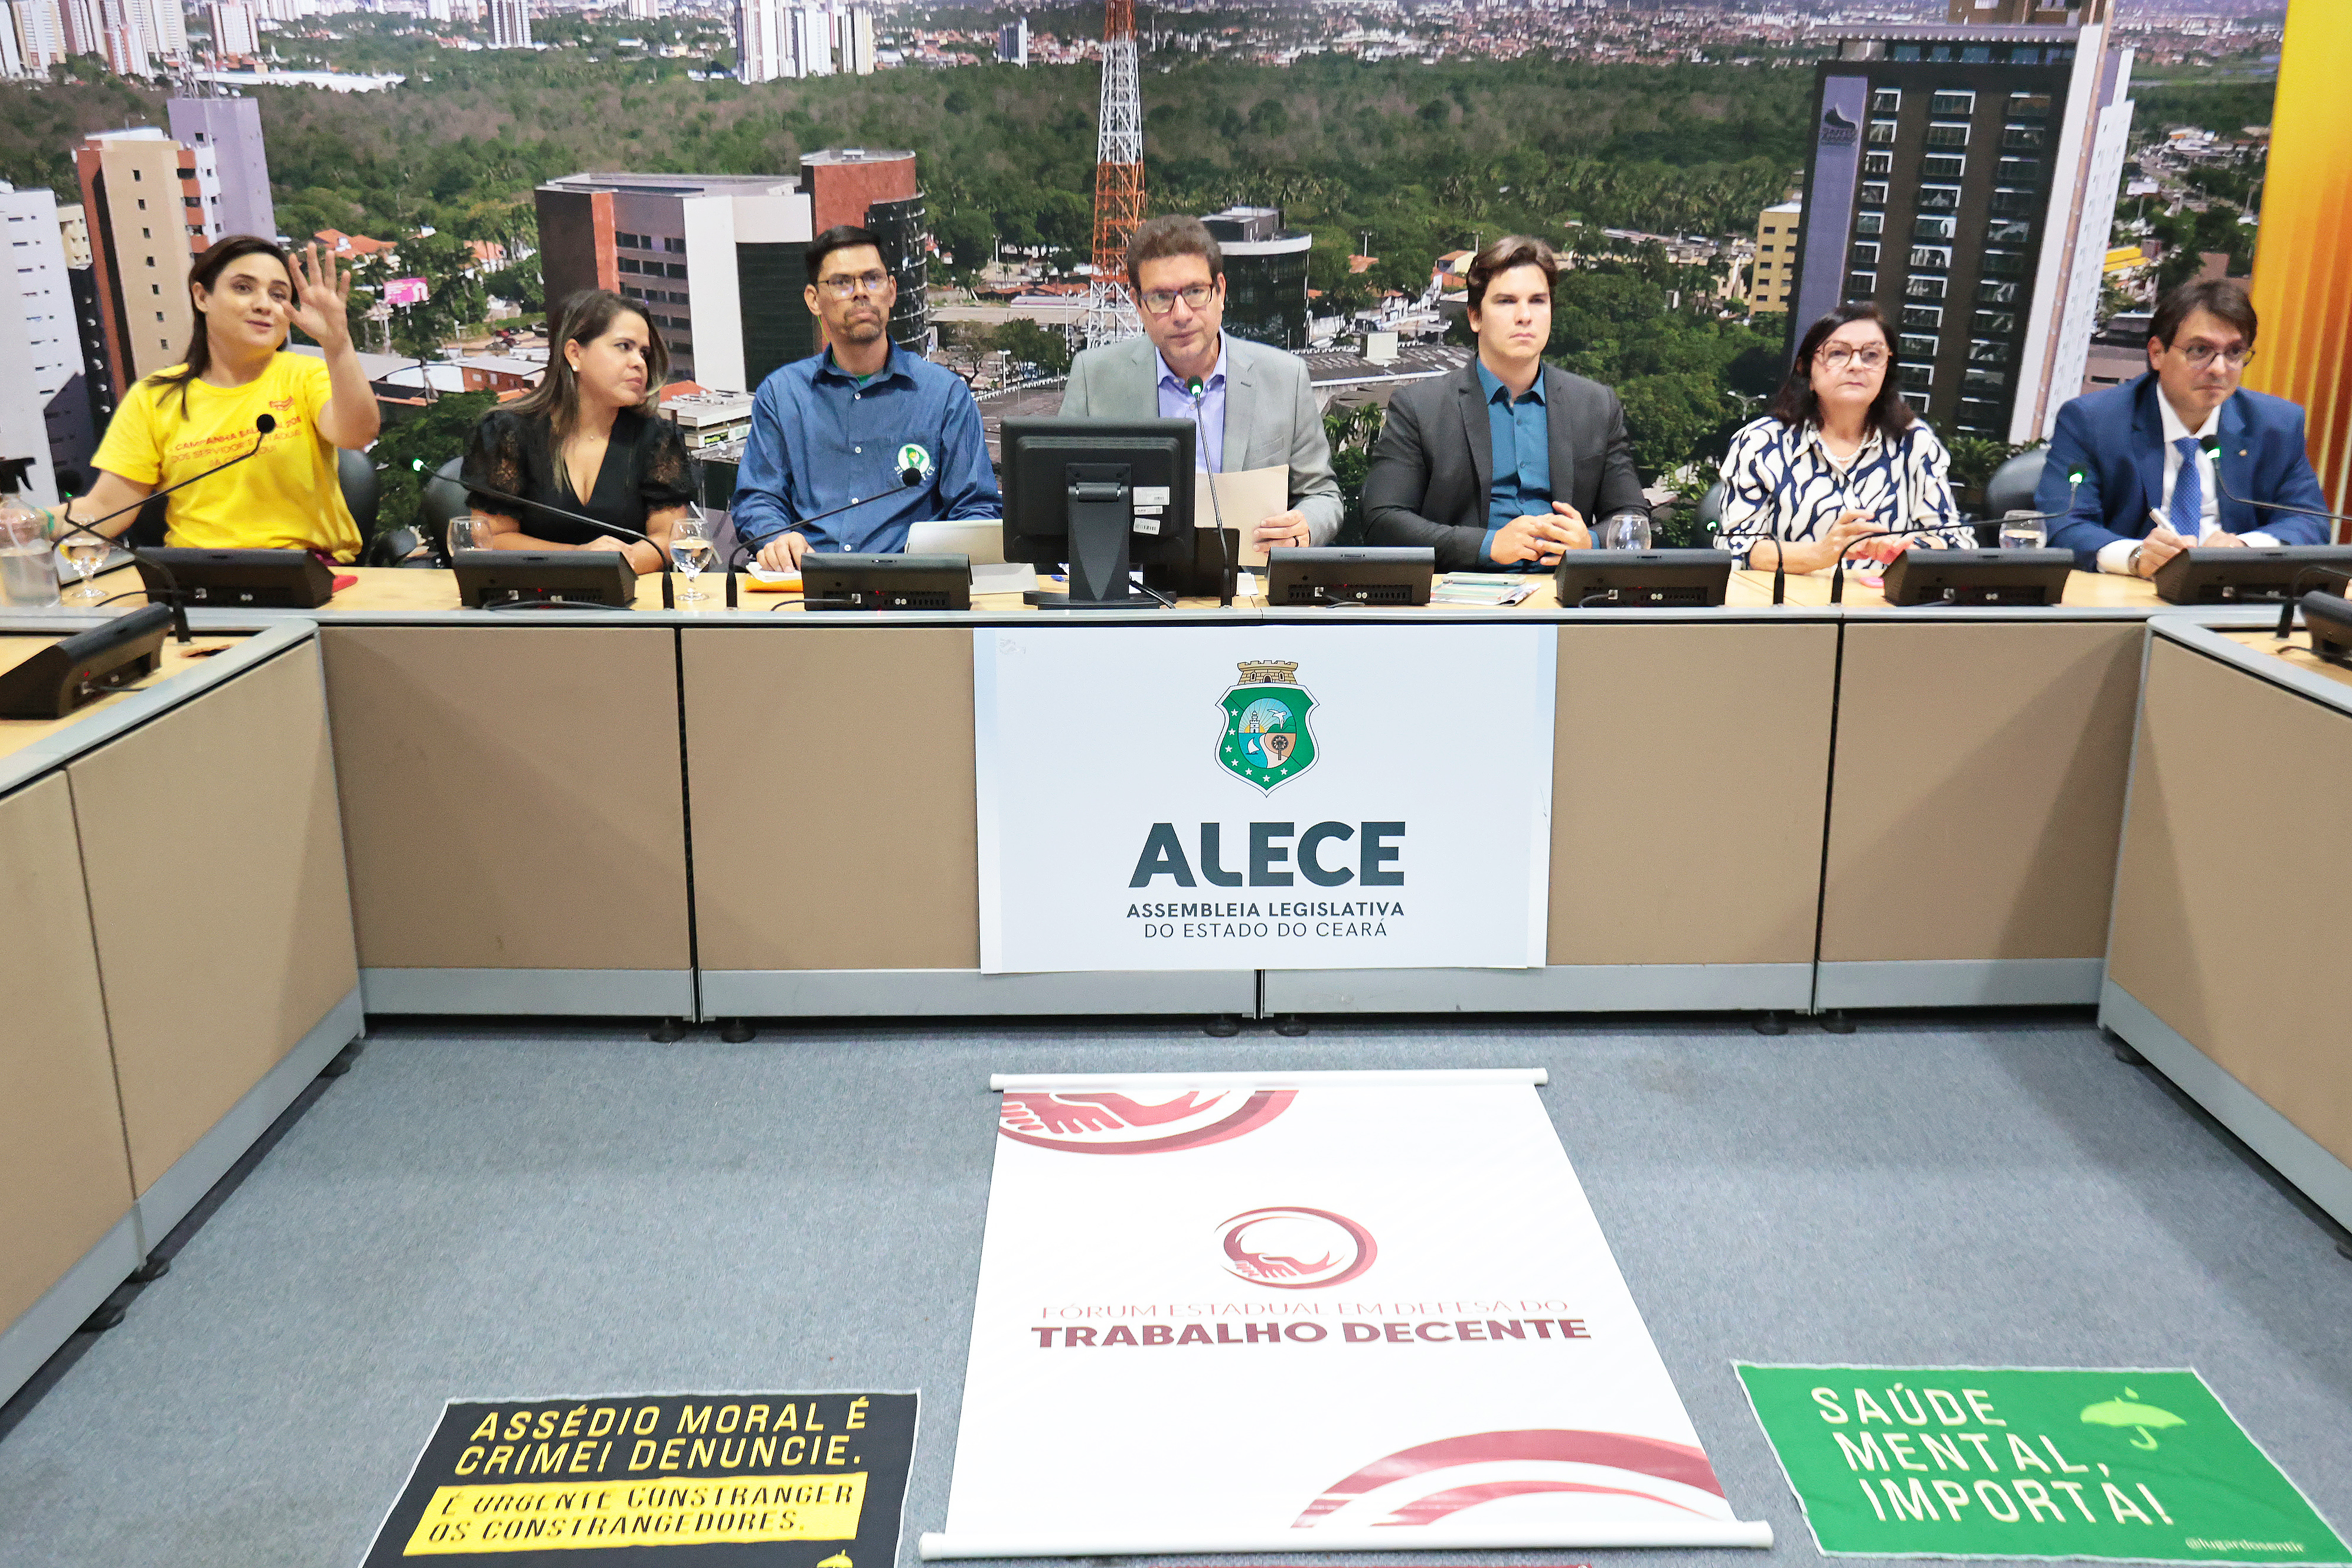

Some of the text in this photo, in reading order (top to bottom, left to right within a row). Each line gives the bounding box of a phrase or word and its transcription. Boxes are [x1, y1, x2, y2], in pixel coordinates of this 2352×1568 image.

[1128, 821, 1405, 887] ALECE
[1127, 902, 1404, 918] ASSEMBLEIA LEGISLATIVA
[1145, 917, 1387, 937] DO ESTADO DO CEARÁ
[1043, 1303, 1156, 1320] FÓRUM
[1169, 1302, 1328, 1317] ESTADUAL
[1338, 1302, 1382, 1316] EM
[1520, 1300, 1568, 1312] DO
[1031, 1318, 1592, 1348] TRABALHO DECENTE
[470, 1395, 870, 1442] ASSÉDIO MORAL É
[1811, 1382, 2007, 1427] SAÚDE
[628, 1435, 861, 1471] DENUNCIE.
[1832, 1431, 2109, 1478] MENTAL,
[442, 1482, 854, 1516] É URGENTE CONSTRANGER
[1858, 1477, 2174, 1525] IMPORTA!
[429, 1521, 471, 1543] OS
